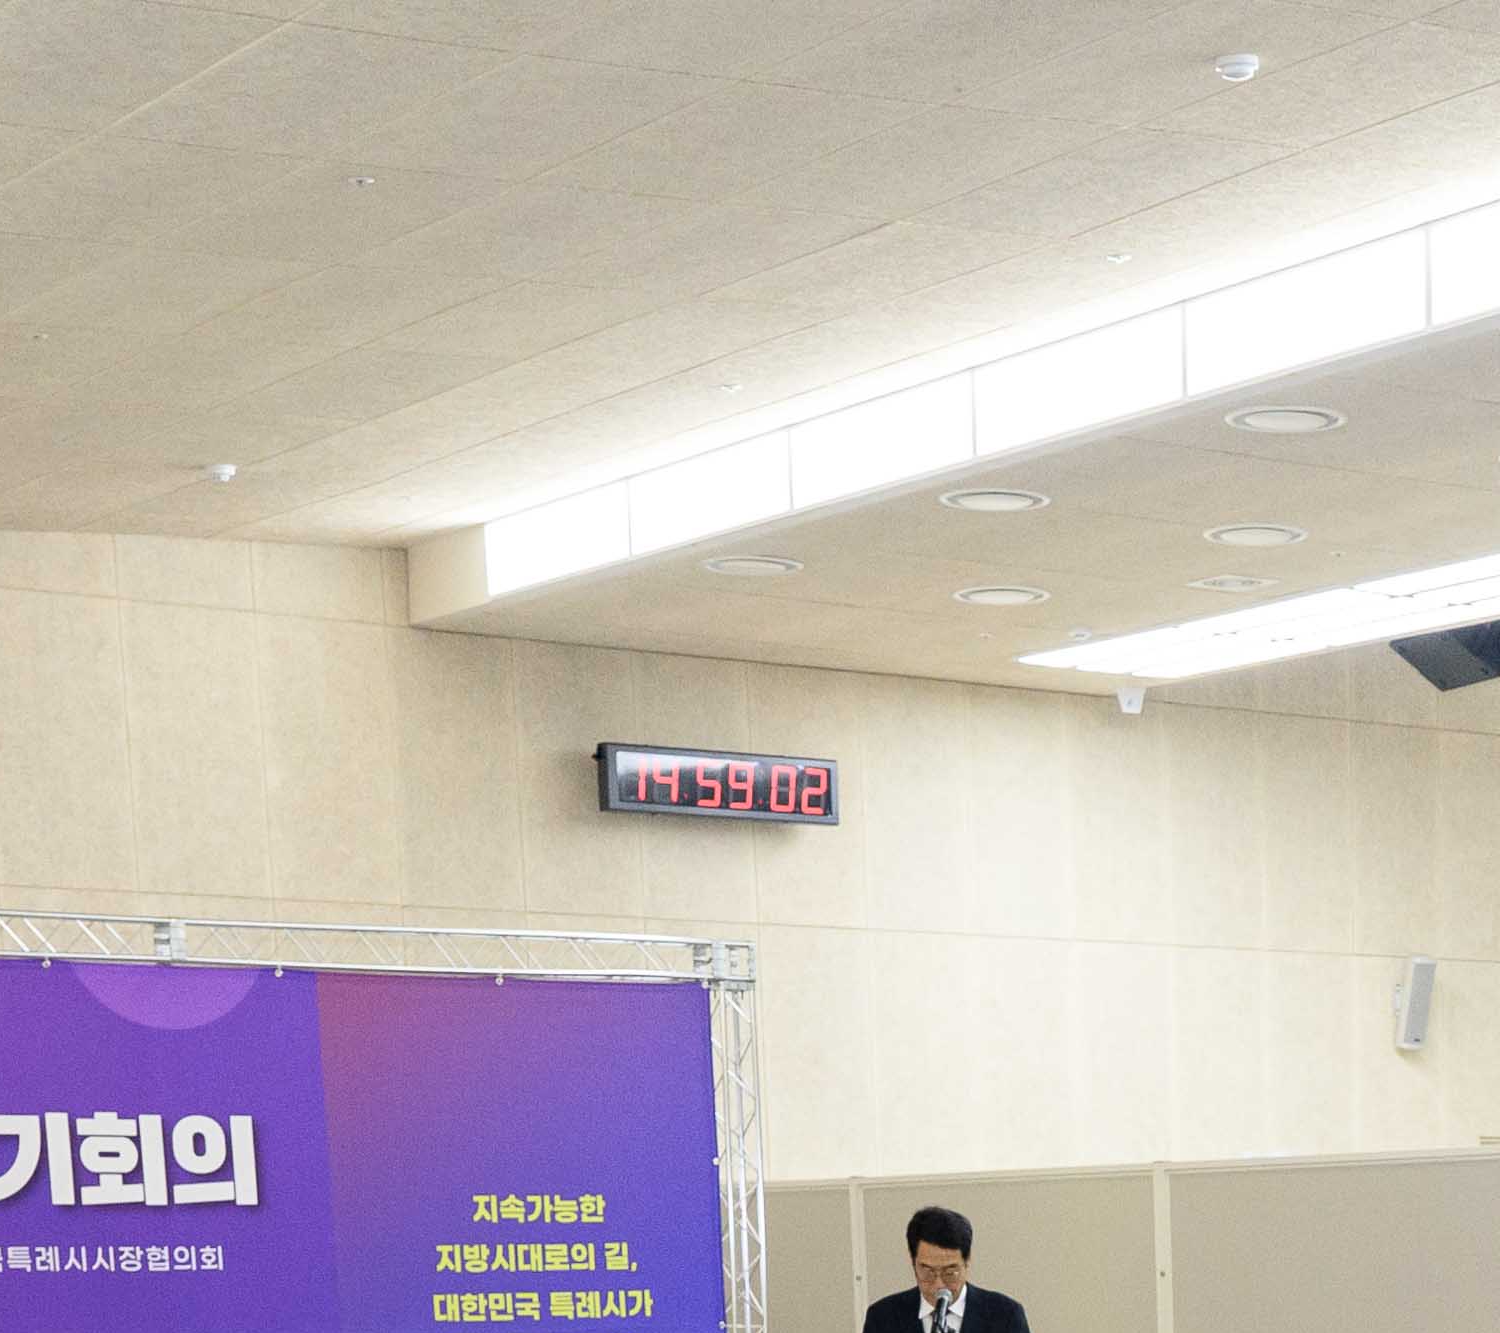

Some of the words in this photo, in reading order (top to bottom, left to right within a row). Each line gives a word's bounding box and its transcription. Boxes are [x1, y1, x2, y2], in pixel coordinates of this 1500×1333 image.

[472, 1193, 606, 1224] 지속가능한
[435, 1243, 596, 1273] 지방시대로의
[604, 1241, 638, 1272] 길,
[432, 1291, 541, 1322] 대한민국
[550, 1289, 654, 1320] 특례시가
